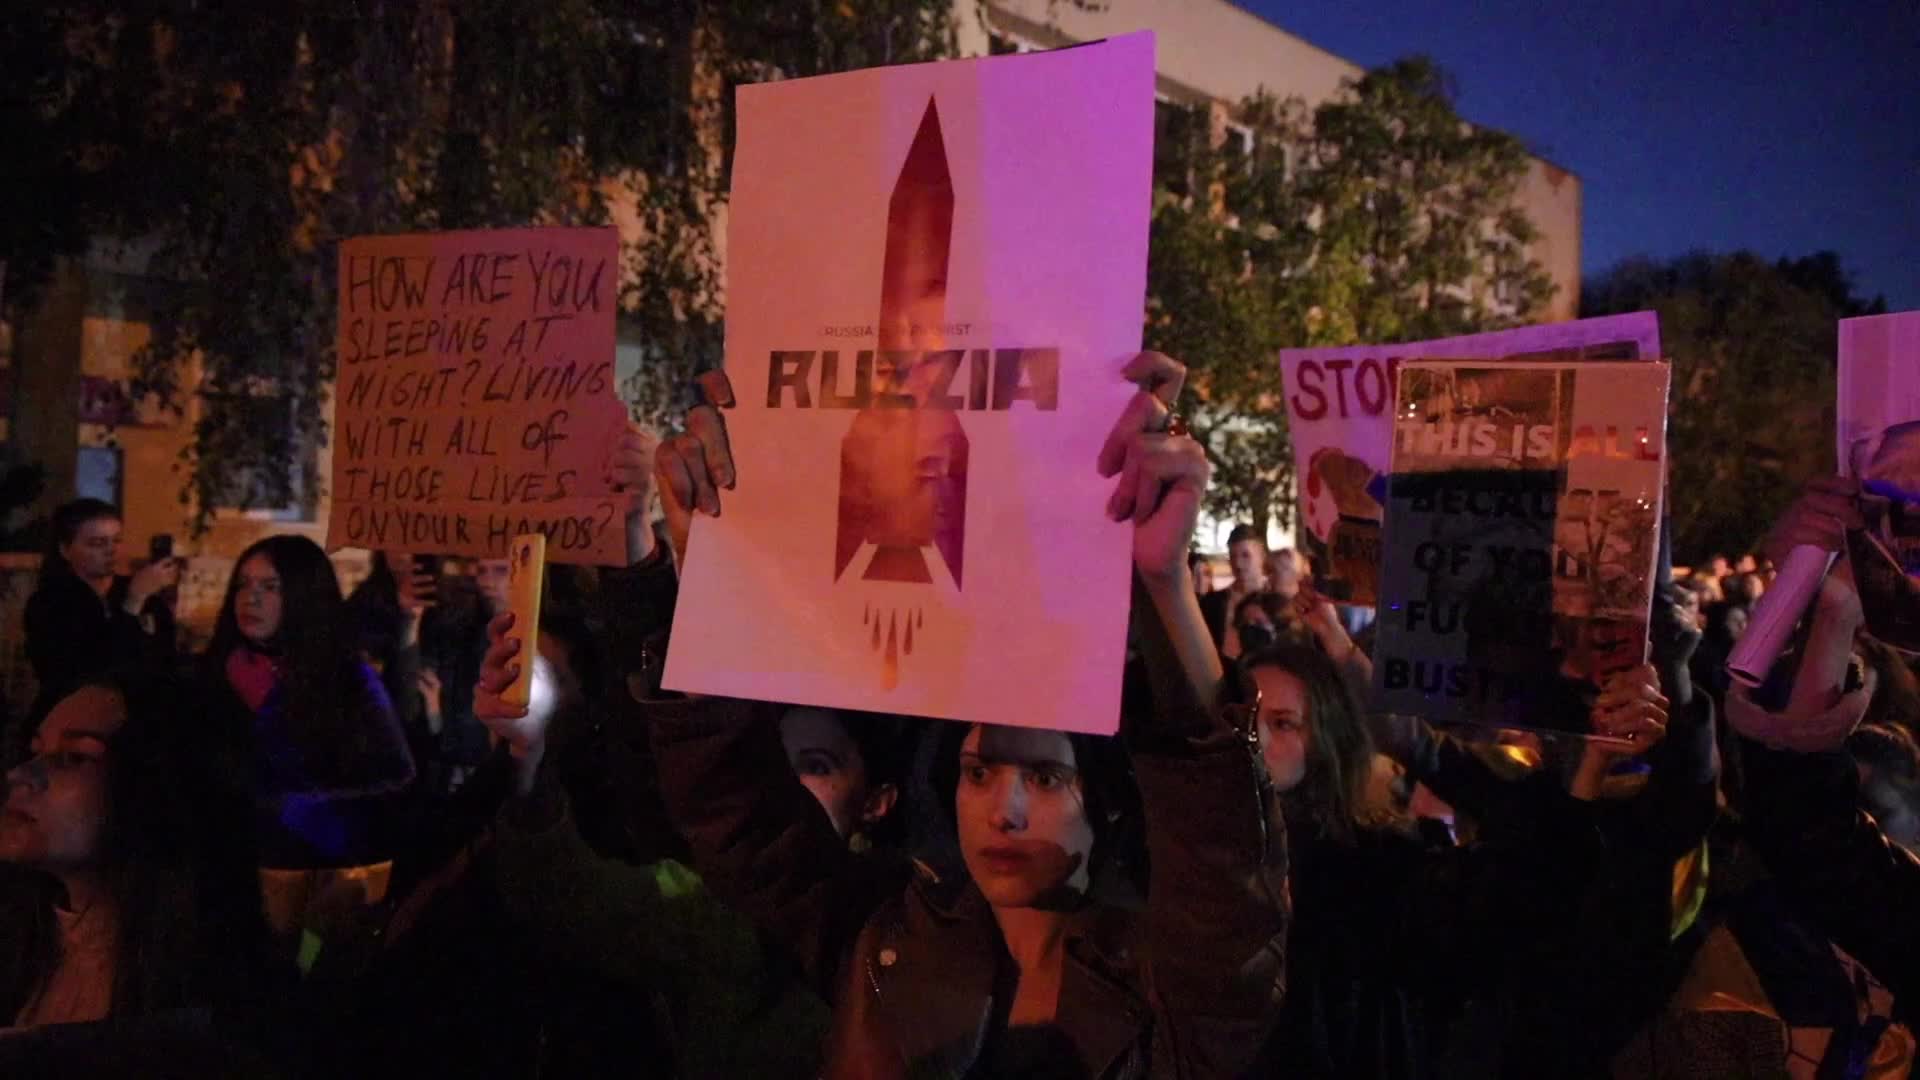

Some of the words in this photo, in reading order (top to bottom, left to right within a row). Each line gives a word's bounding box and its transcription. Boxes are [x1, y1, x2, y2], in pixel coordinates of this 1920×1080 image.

[349, 255, 436, 313] HOW
[441, 252, 520, 304] ARE
[527, 251, 606, 313] YOU
[502, 314, 575, 353] AT
[766, 348, 1060, 411] RUZZIA
[446, 416, 498, 456] ALL
[1398, 421, 1498, 457] THIS
[1511, 423, 1554, 459] IS
[1567, 425, 1660, 461] ALL
[345, 466, 443, 505] THOSE
[1413, 541, 1474, 577] OF
